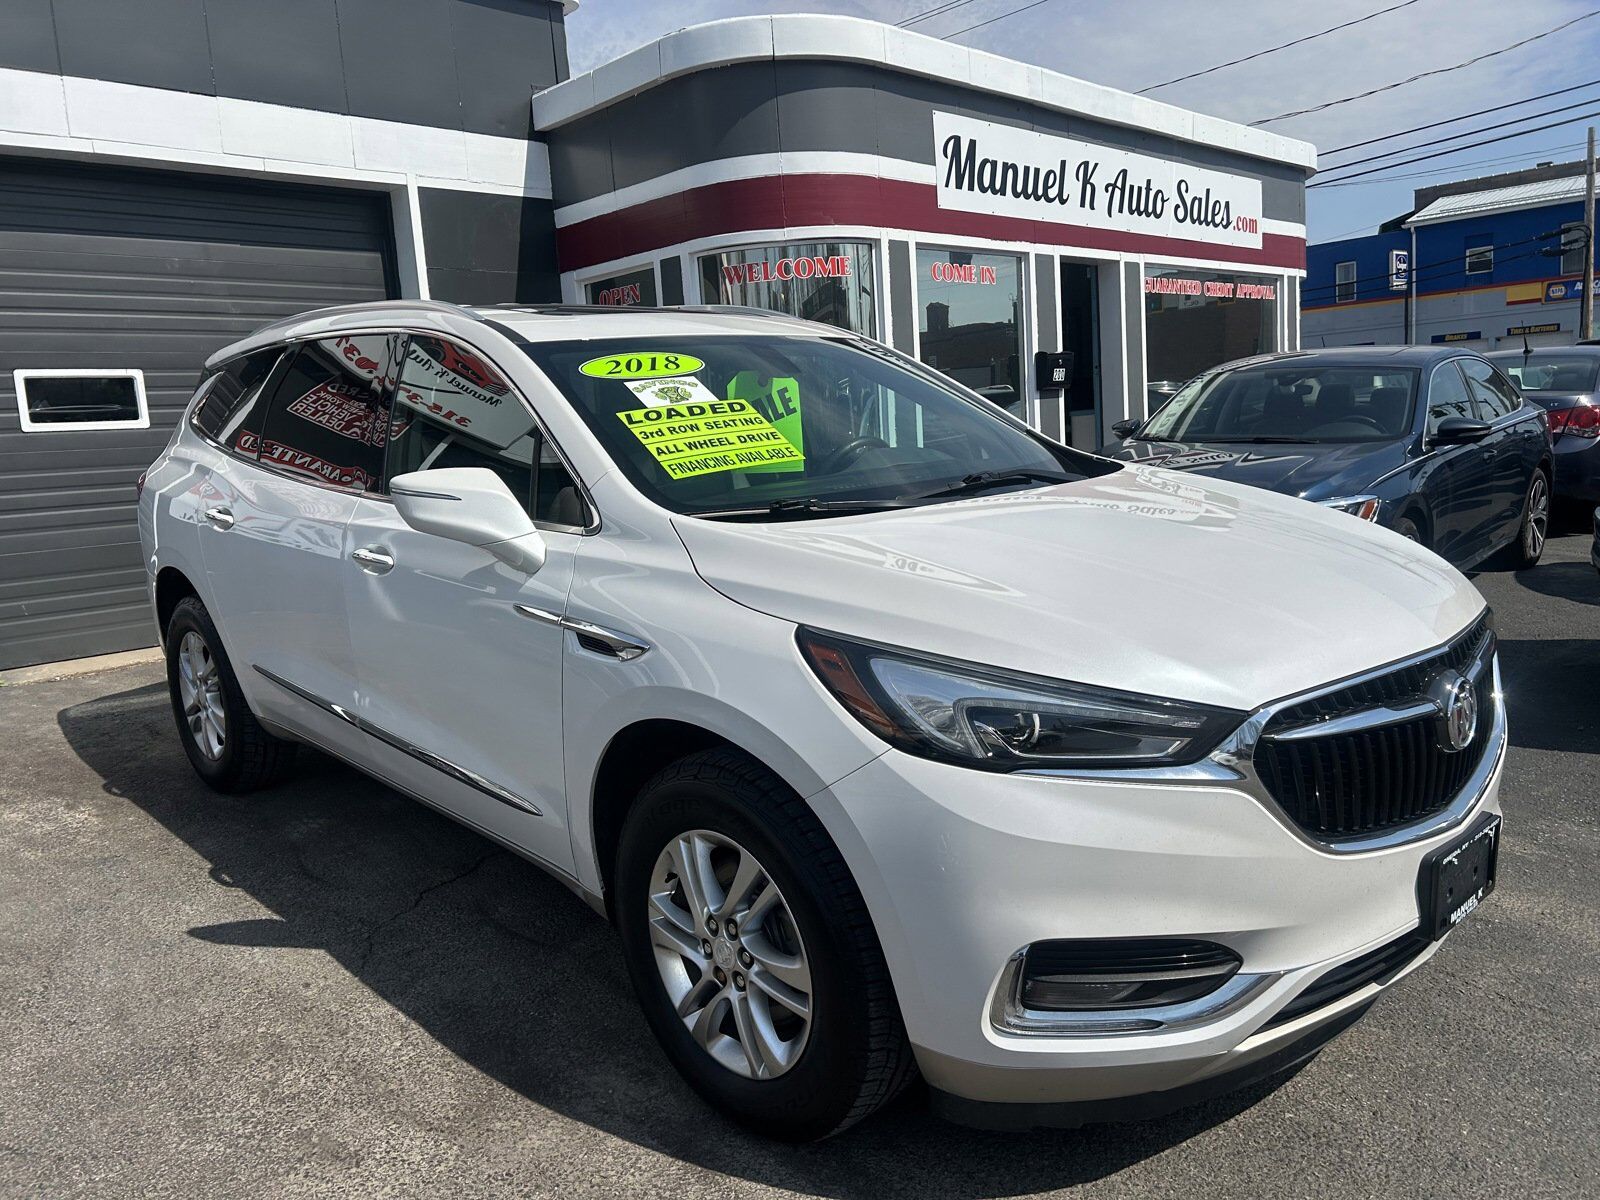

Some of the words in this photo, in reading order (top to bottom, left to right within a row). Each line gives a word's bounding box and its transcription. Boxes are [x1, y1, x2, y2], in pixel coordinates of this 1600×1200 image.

[942, 134, 1069, 205] Manuel
[1075, 160, 1100, 211] K
[1104, 168, 1169, 218] Auto
[721, 255, 852, 286] WELCOME
[931, 262, 977, 283] COME
[980, 265, 997, 285] IN
[598, 282, 641, 306] OPEN
[1203, 281, 1234, 298] CREDIT
[1236, 283, 1276, 300] APPROVAL
[605, 354, 681, 376] 2018
[624, 401, 748, 426] LOADED
[638, 427, 664, 441] 3rd
[669, 423, 700, 436] ROW
[705, 416, 764, 432] SEATING
[655, 443, 683, 458] ALL
[683, 435, 736, 453] WHEEL
[738, 431, 782, 445] DRIVE
[667, 457, 735, 477] FINANCING
[735, 447, 798, 467] AVAILABLE
